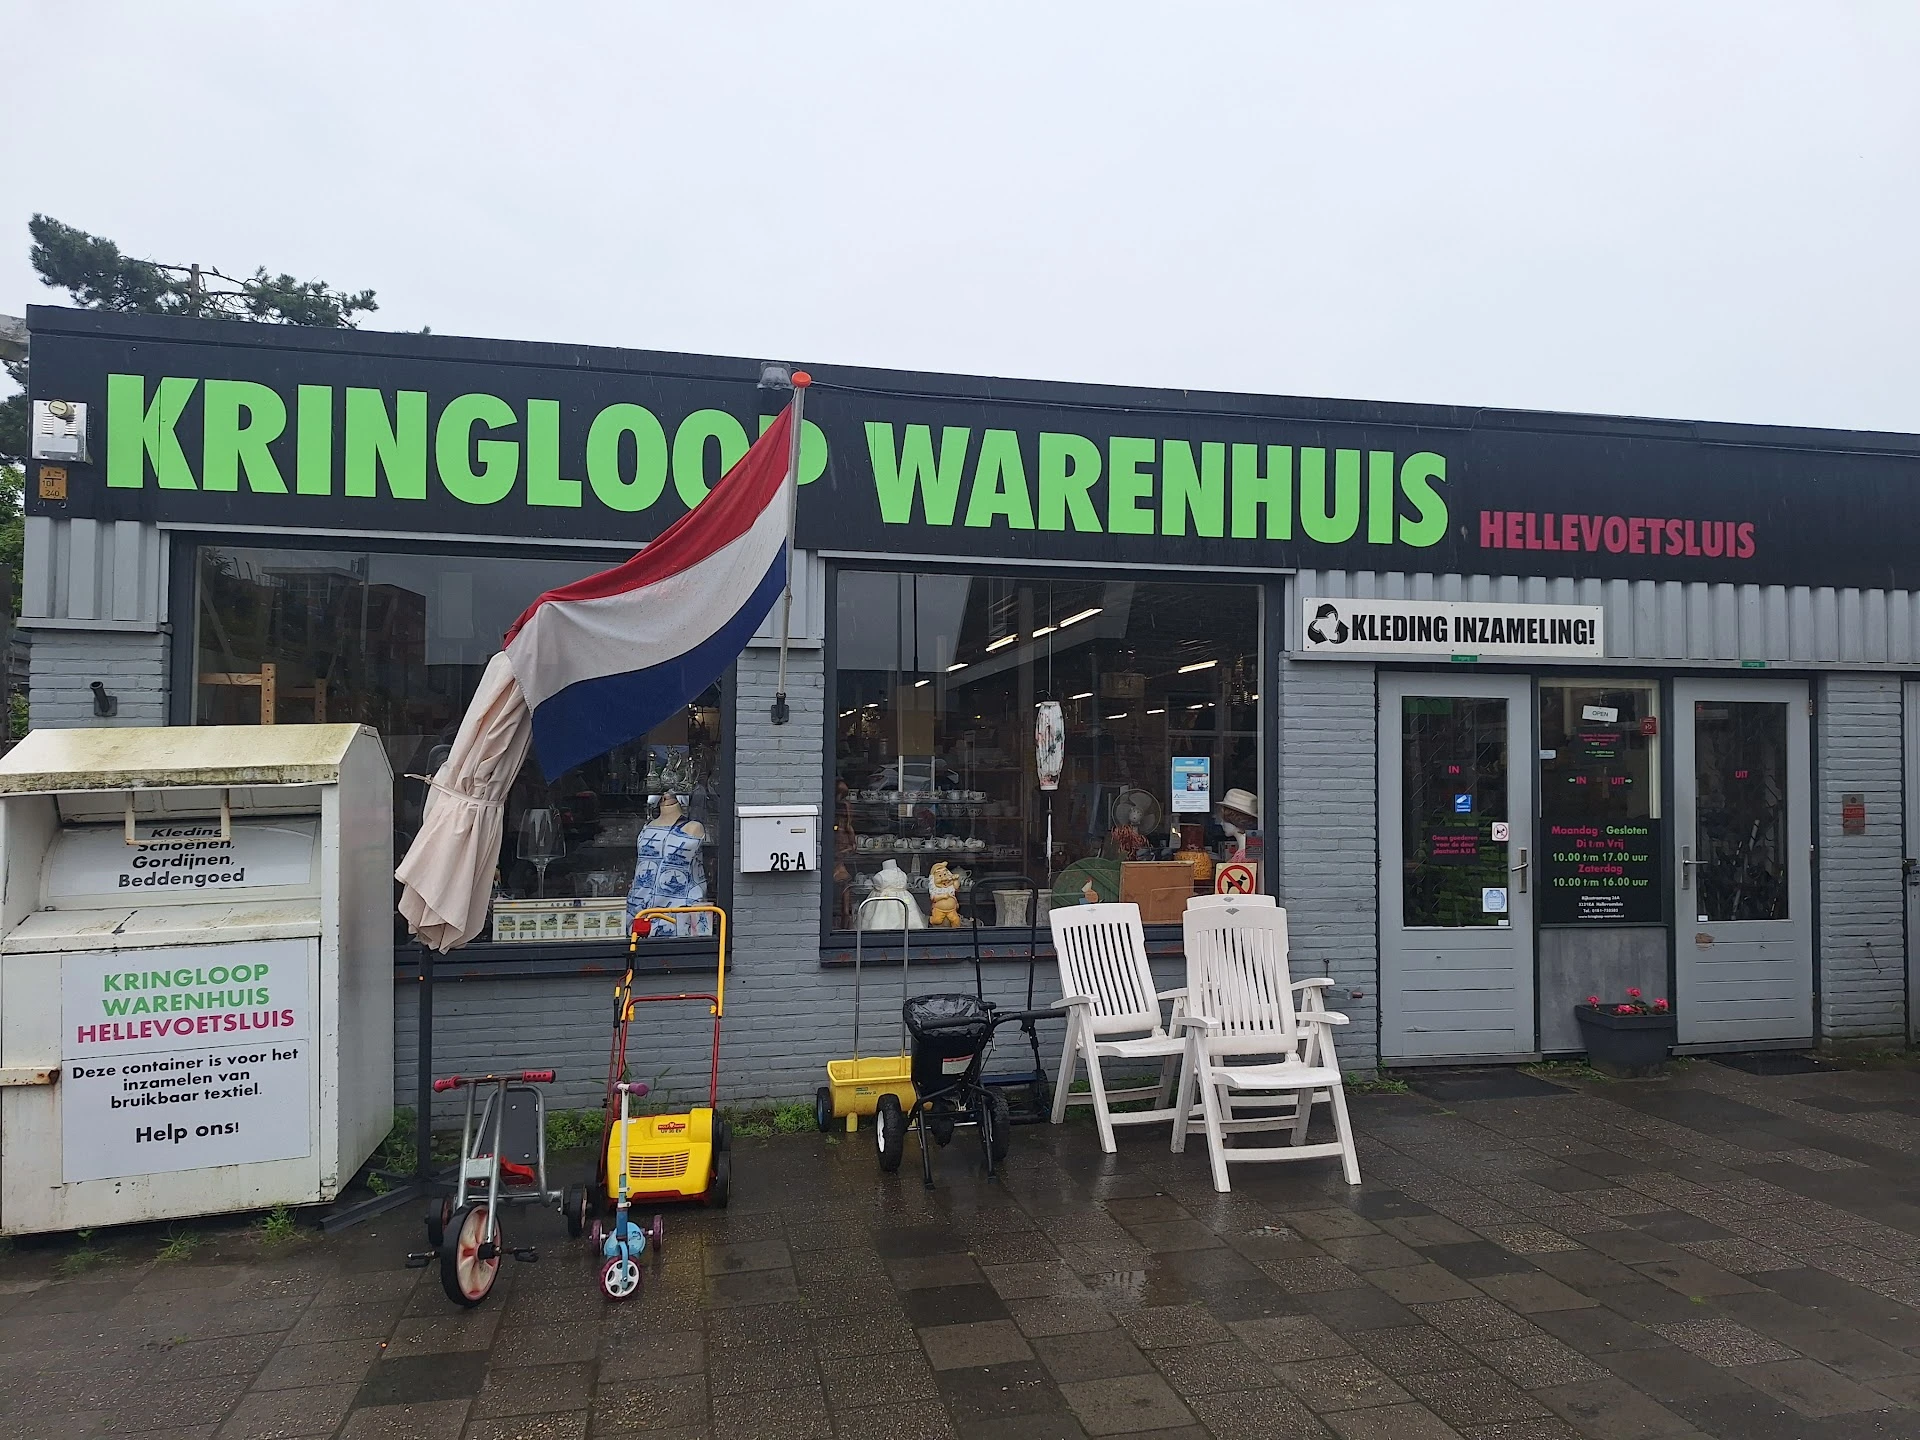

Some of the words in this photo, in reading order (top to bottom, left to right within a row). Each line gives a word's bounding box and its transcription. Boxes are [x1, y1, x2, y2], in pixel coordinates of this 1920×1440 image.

[45, 489, 60, 497] 240
[864, 421, 1451, 549] WARENHUIS
[1479, 509, 1757, 560] HELLEVOETSLUIS
[1352, 614, 1448, 643] KLEDING
[1454, 616, 1596, 645] INZAMELING!
[1592, 710, 1609, 718] OPEN
[1448, 765, 1460, 774] IN
[1735, 770, 1748, 779] UIT
[1576, 776, 1587, 785] IN
[1611, 777, 1625, 785] UIT
[1449, 835, 1478, 843] goederen
[1551, 825, 1598, 837] Maandag
[1606, 825, 1648, 835] Gesloten
[1576, 839, 1587, 848] Di
[1589, 839, 1605, 848] t/m
[1607, 839, 1625, 850] Vrij
[132, 853, 235, 870] Gordijnen,
[770, 851, 807, 871] 26-A
[1553, 852, 1580, 862] 10.00
[1583, 853, 1599, 862] t/m
[1602, 852, 1630, 862] 17.00
[118, 867, 246, 888] Beddengoed
[1578, 864, 1623, 875] Zaterdag
[1553, 877, 1581, 887] 10.00
[1583, 878, 1599, 887] t/m
[1602, 877, 1630, 887] 16.00
[104, 963, 270, 993] KRINGLOOP
[102, 987, 271, 1017] WARENHUIS
[77, 1009, 295, 1044] HELLEVOETSLUIS
[72, 1066, 117, 1080] Deze
[122, 1057, 205, 1076] container
[208, 1054, 223, 1068] is
[227, 1052, 268, 1066] voor
[272, 1048, 300, 1062] het
[123, 1072, 213, 1092] inzamelen
[218, 1071, 251, 1083] van
[110, 1090, 200, 1109] bruikbaar
[204, 1082, 263, 1100] textiel.
[135, 1123, 188, 1144] Help
[195, 1121, 240, 1138] ons!
